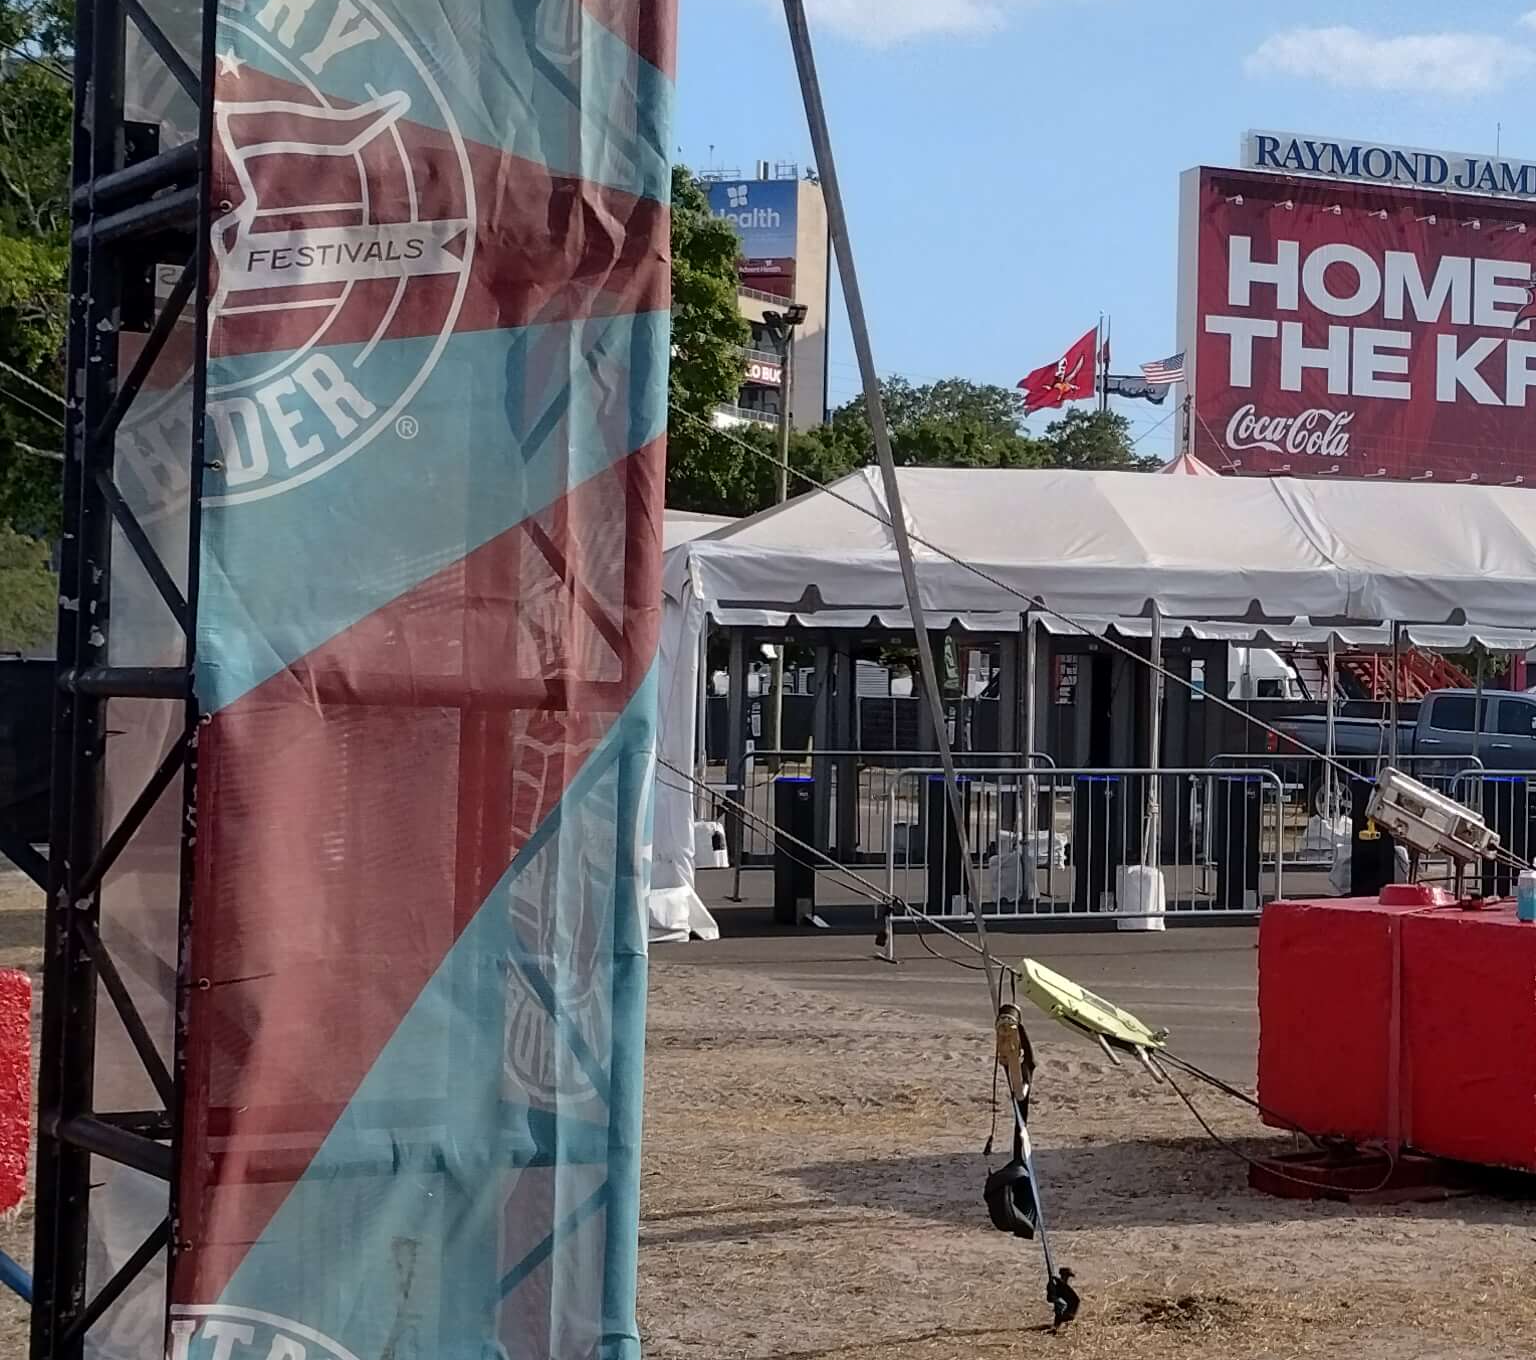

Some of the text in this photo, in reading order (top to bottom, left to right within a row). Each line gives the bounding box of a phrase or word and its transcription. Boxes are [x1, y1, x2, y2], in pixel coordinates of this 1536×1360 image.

[1254, 135, 1448, 186] RAYMOND
[247, 238, 425, 273] FESTIVALS
[1227, 235, 1532, 331] HOME
[1204, 314, 1412, 401] THE
[206, 352, 376, 487] DER
[1226, 404, 1354, 456] Coca-Cola
